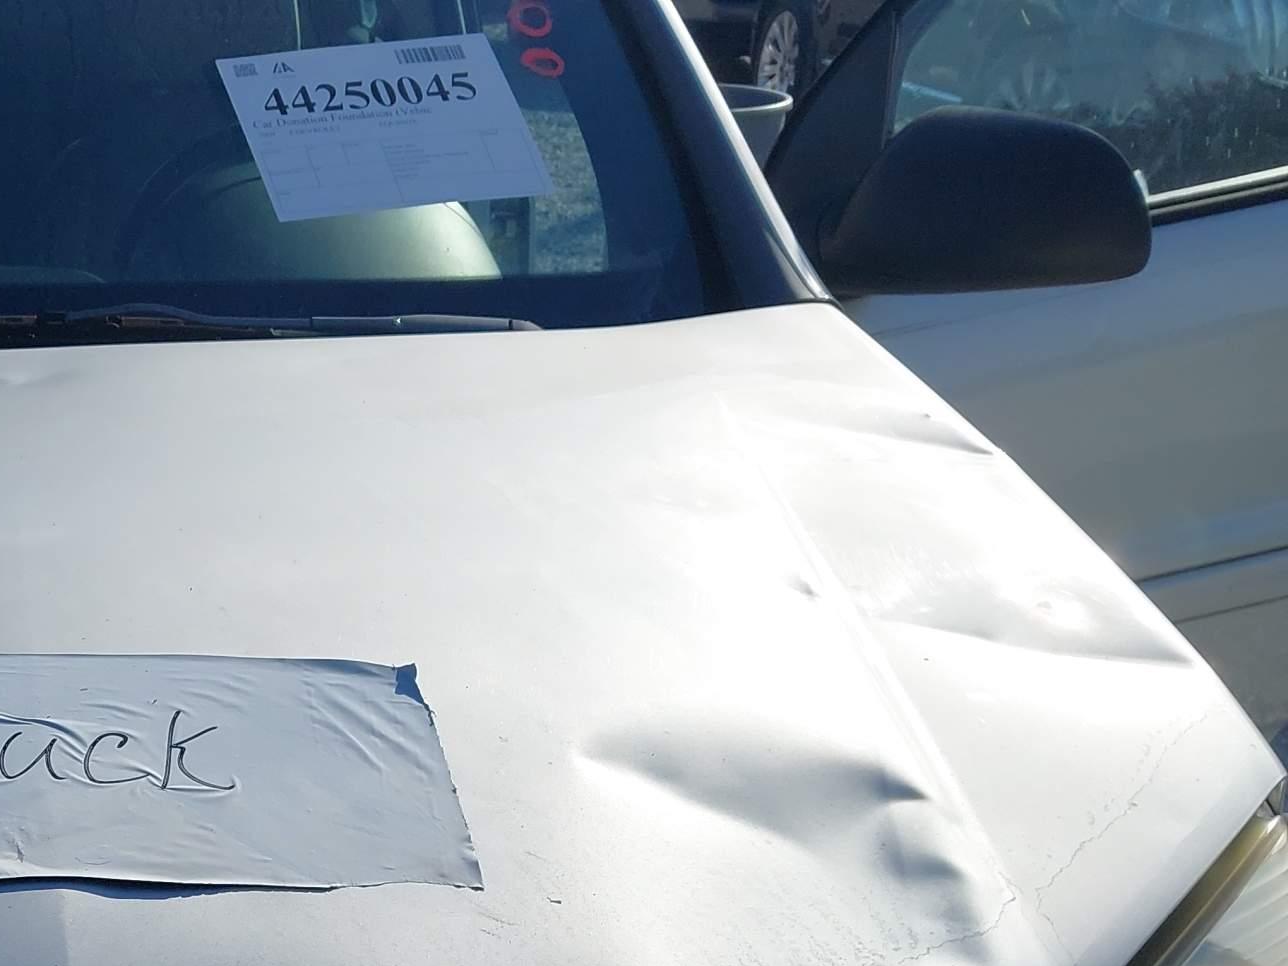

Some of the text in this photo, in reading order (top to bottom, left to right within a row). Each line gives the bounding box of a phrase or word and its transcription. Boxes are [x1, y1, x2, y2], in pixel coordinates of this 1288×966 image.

[264, 72, 477, 116] 44250045
[276, 115, 328, 127] Donation
[330, 109, 393, 123] Foundation
